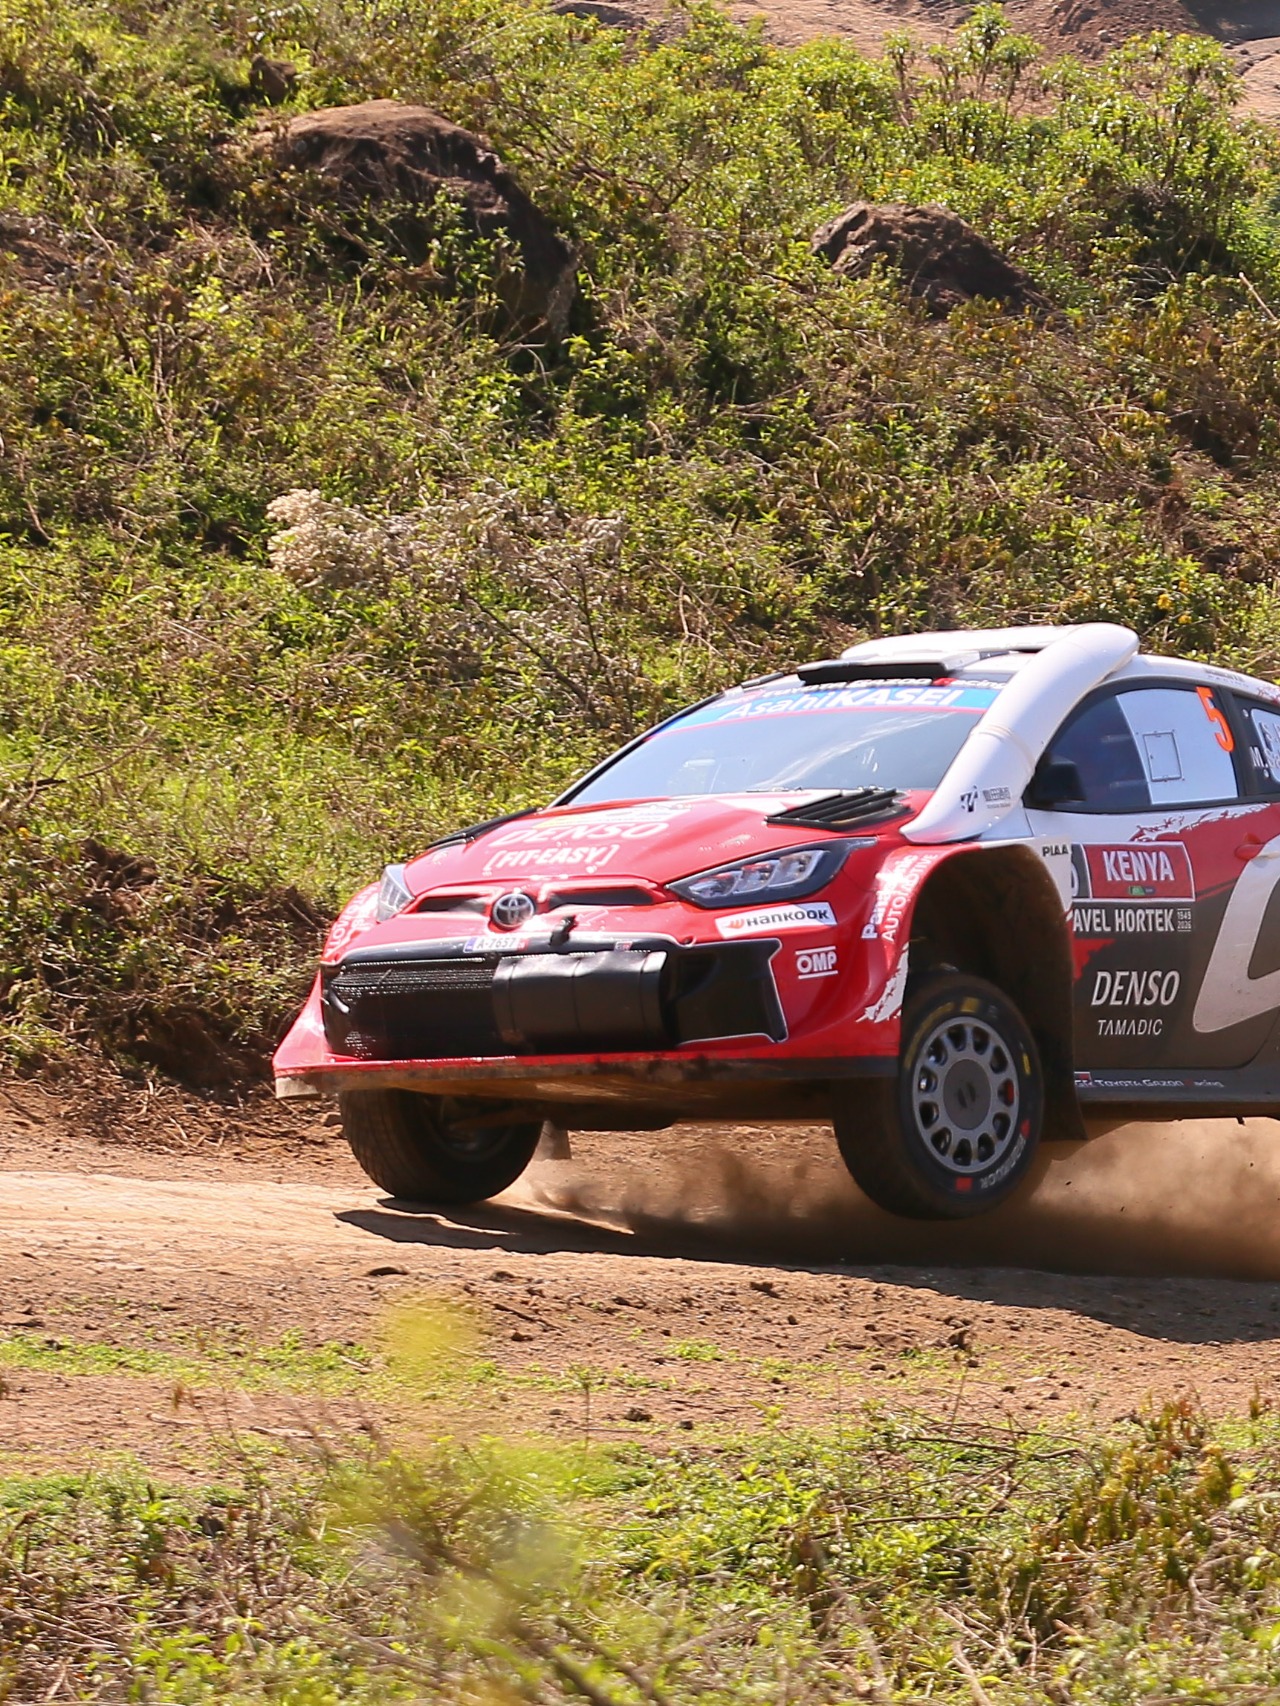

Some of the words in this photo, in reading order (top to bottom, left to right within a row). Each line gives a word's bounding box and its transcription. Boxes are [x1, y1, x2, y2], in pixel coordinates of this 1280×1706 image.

[1196, 686, 1235, 752] 5
[488, 822, 669, 847] DENSO
[1042, 844, 1069, 857] PIAA
[1102, 850, 1175, 882] KENYA
[881, 854, 938, 942] AUTOMOTIVE
[1115, 908, 1175, 933] HORTEK
[796, 951, 838, 974] OMP
[1091, 970, 1181, 1006] DENSO
[1098, 1019, 1163, 1036] TAMADIC
